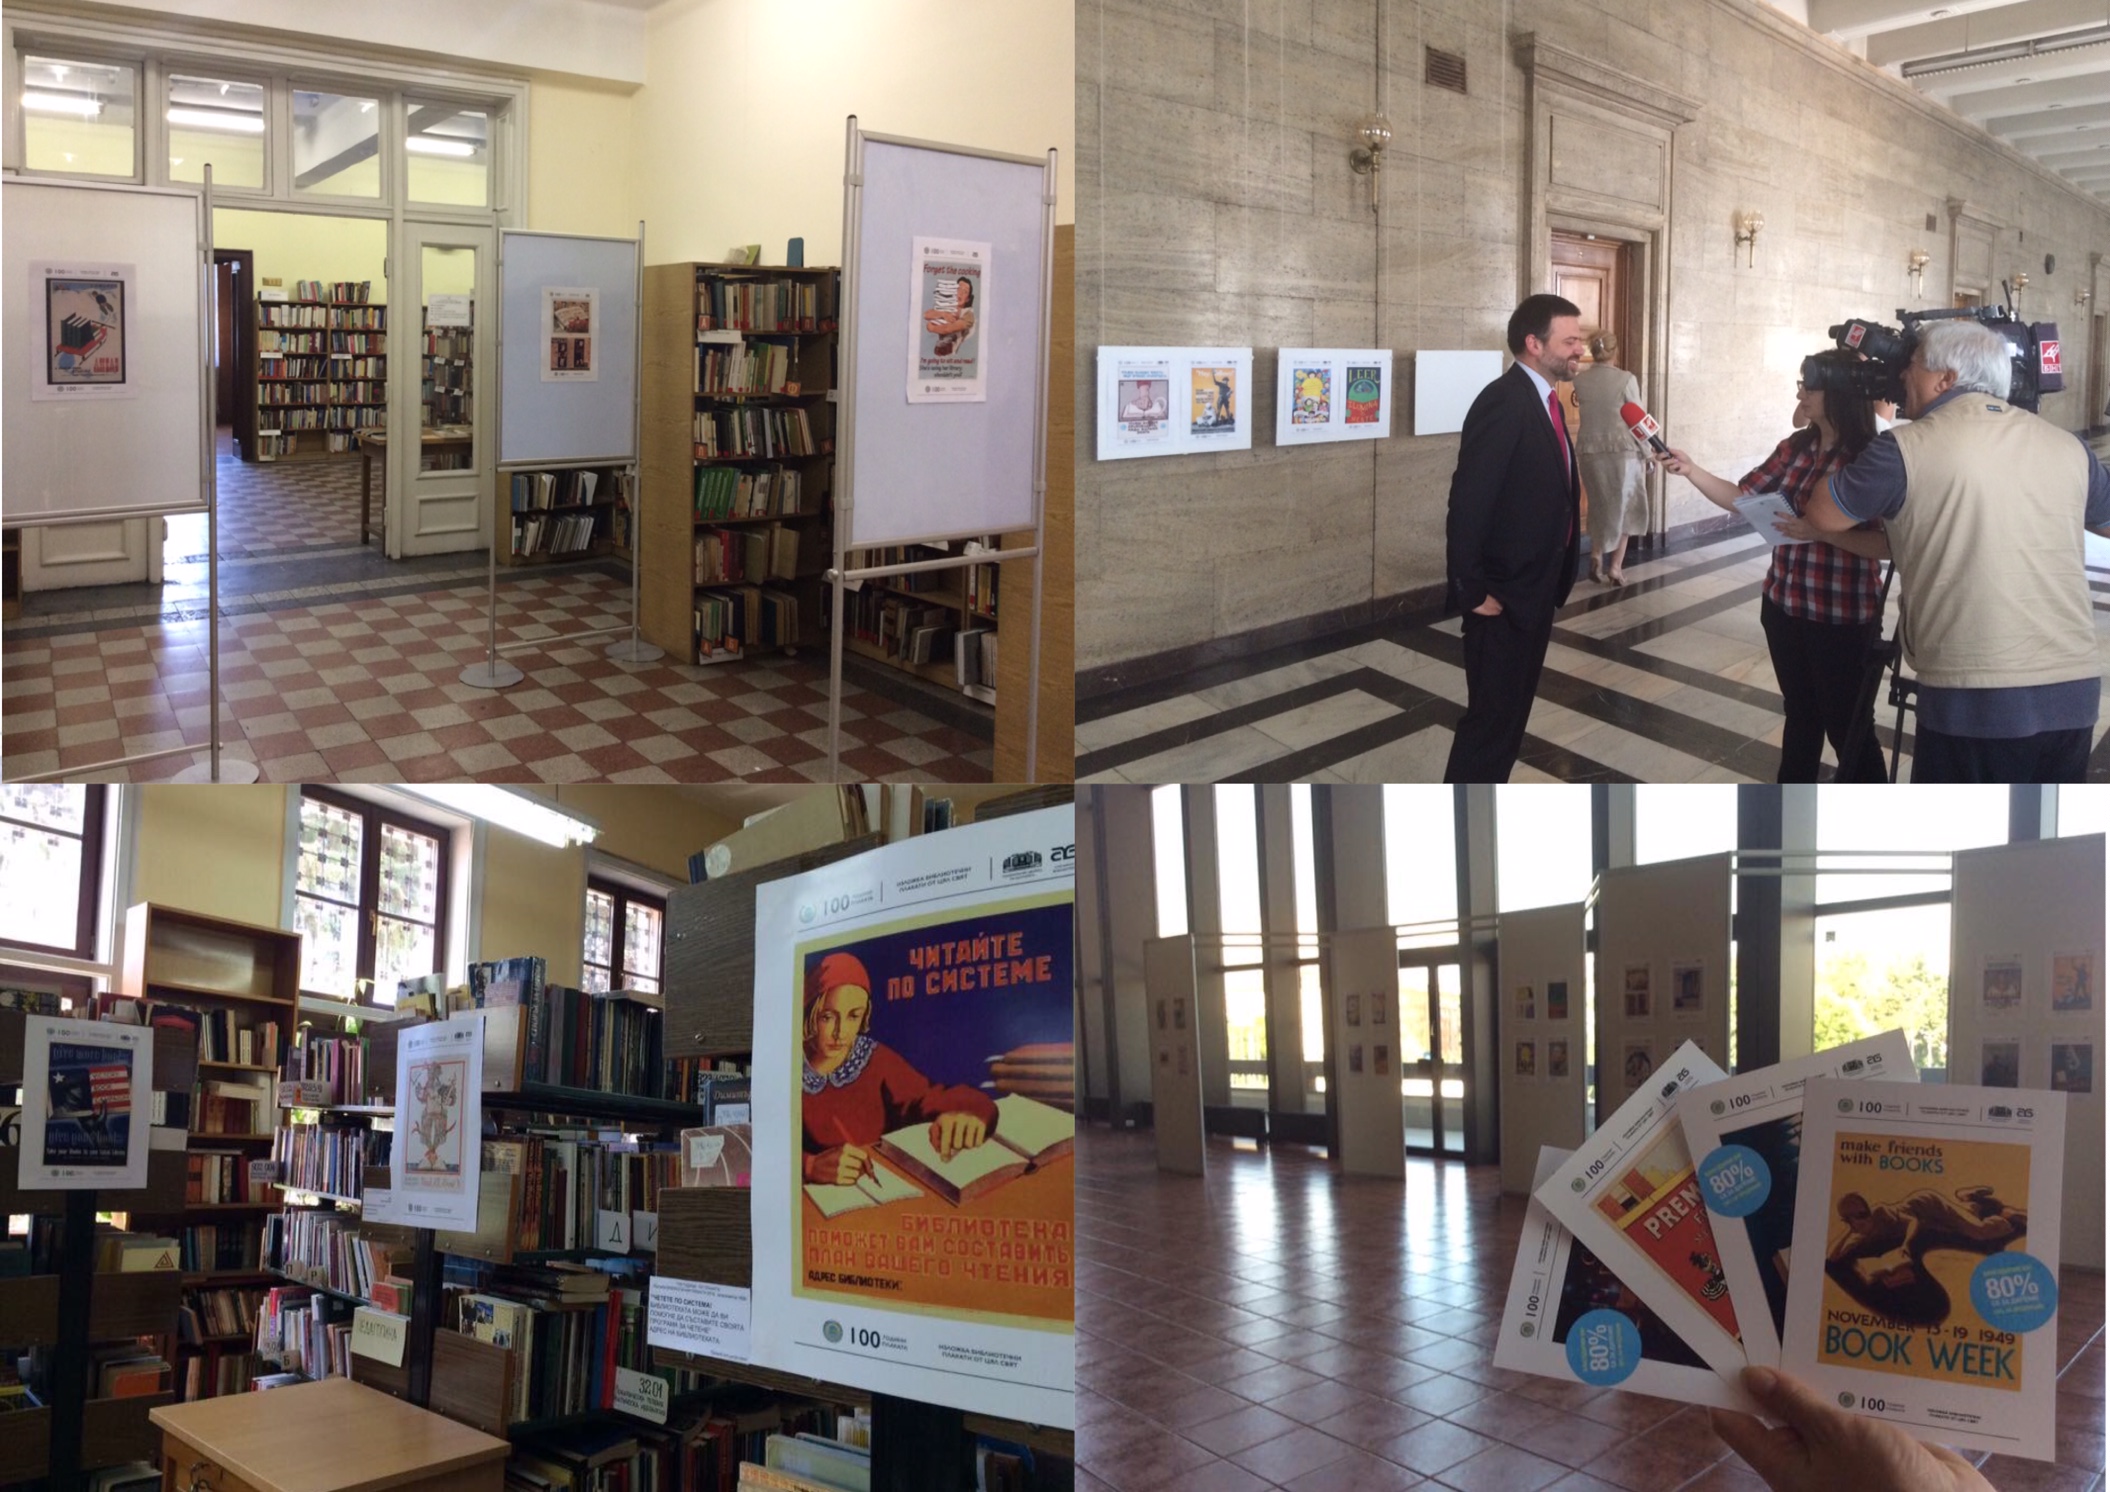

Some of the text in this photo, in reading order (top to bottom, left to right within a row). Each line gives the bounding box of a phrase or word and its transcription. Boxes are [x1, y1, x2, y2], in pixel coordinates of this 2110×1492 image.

[923, 263, 981, 279] Forget the cooking
[1348, 369, 1381, 383] LEER
[824, 894, 850, 916] 100
[909, 931, 1023, 970] ЧИТАЙТЕ
[887, 955, 1052, 1001] ПО СИСТЕМЕ
[1729, 1094, 1751, 1110] 100
[1859, 1101, 1883, 1114] 100
[1840, 1139, 1943, 1158] make friends
[1585, 1159, 1605, 1180] 100
[1840, 1153, 1945, 1174] with BOOKS
[1709, 1159, 1754, 1194] 80%
[608, 1220, 623, 1243] Д
[901, 1213, 1069, 1240] БИБЛИОТЕКА
[808, 1228, 1070, 1264] ПОМОЖЕТ ВАМ СОСТАВИТЬ
[808, 1247, 1071, 1289] ПЛАН ВАШЕГО ЧТЕНИЯ
[808, 1269, 836, 1283] АДРЕС
[1985, 1271, 2039, 1299] 80%
[1525, 1295, 1540, 1317] 100
[850, 1326, 881, 1349] 100
[1827, 1309, 1916, 1334] NOVEMBER
[1979, 1329, 2015, 1345] 1949
[1586, 1324, 1610, 1371] 80%
[1825, 1324, 2015, 1380] BOOK WEEK
[1861, 1396, 1886, 1412] 100
